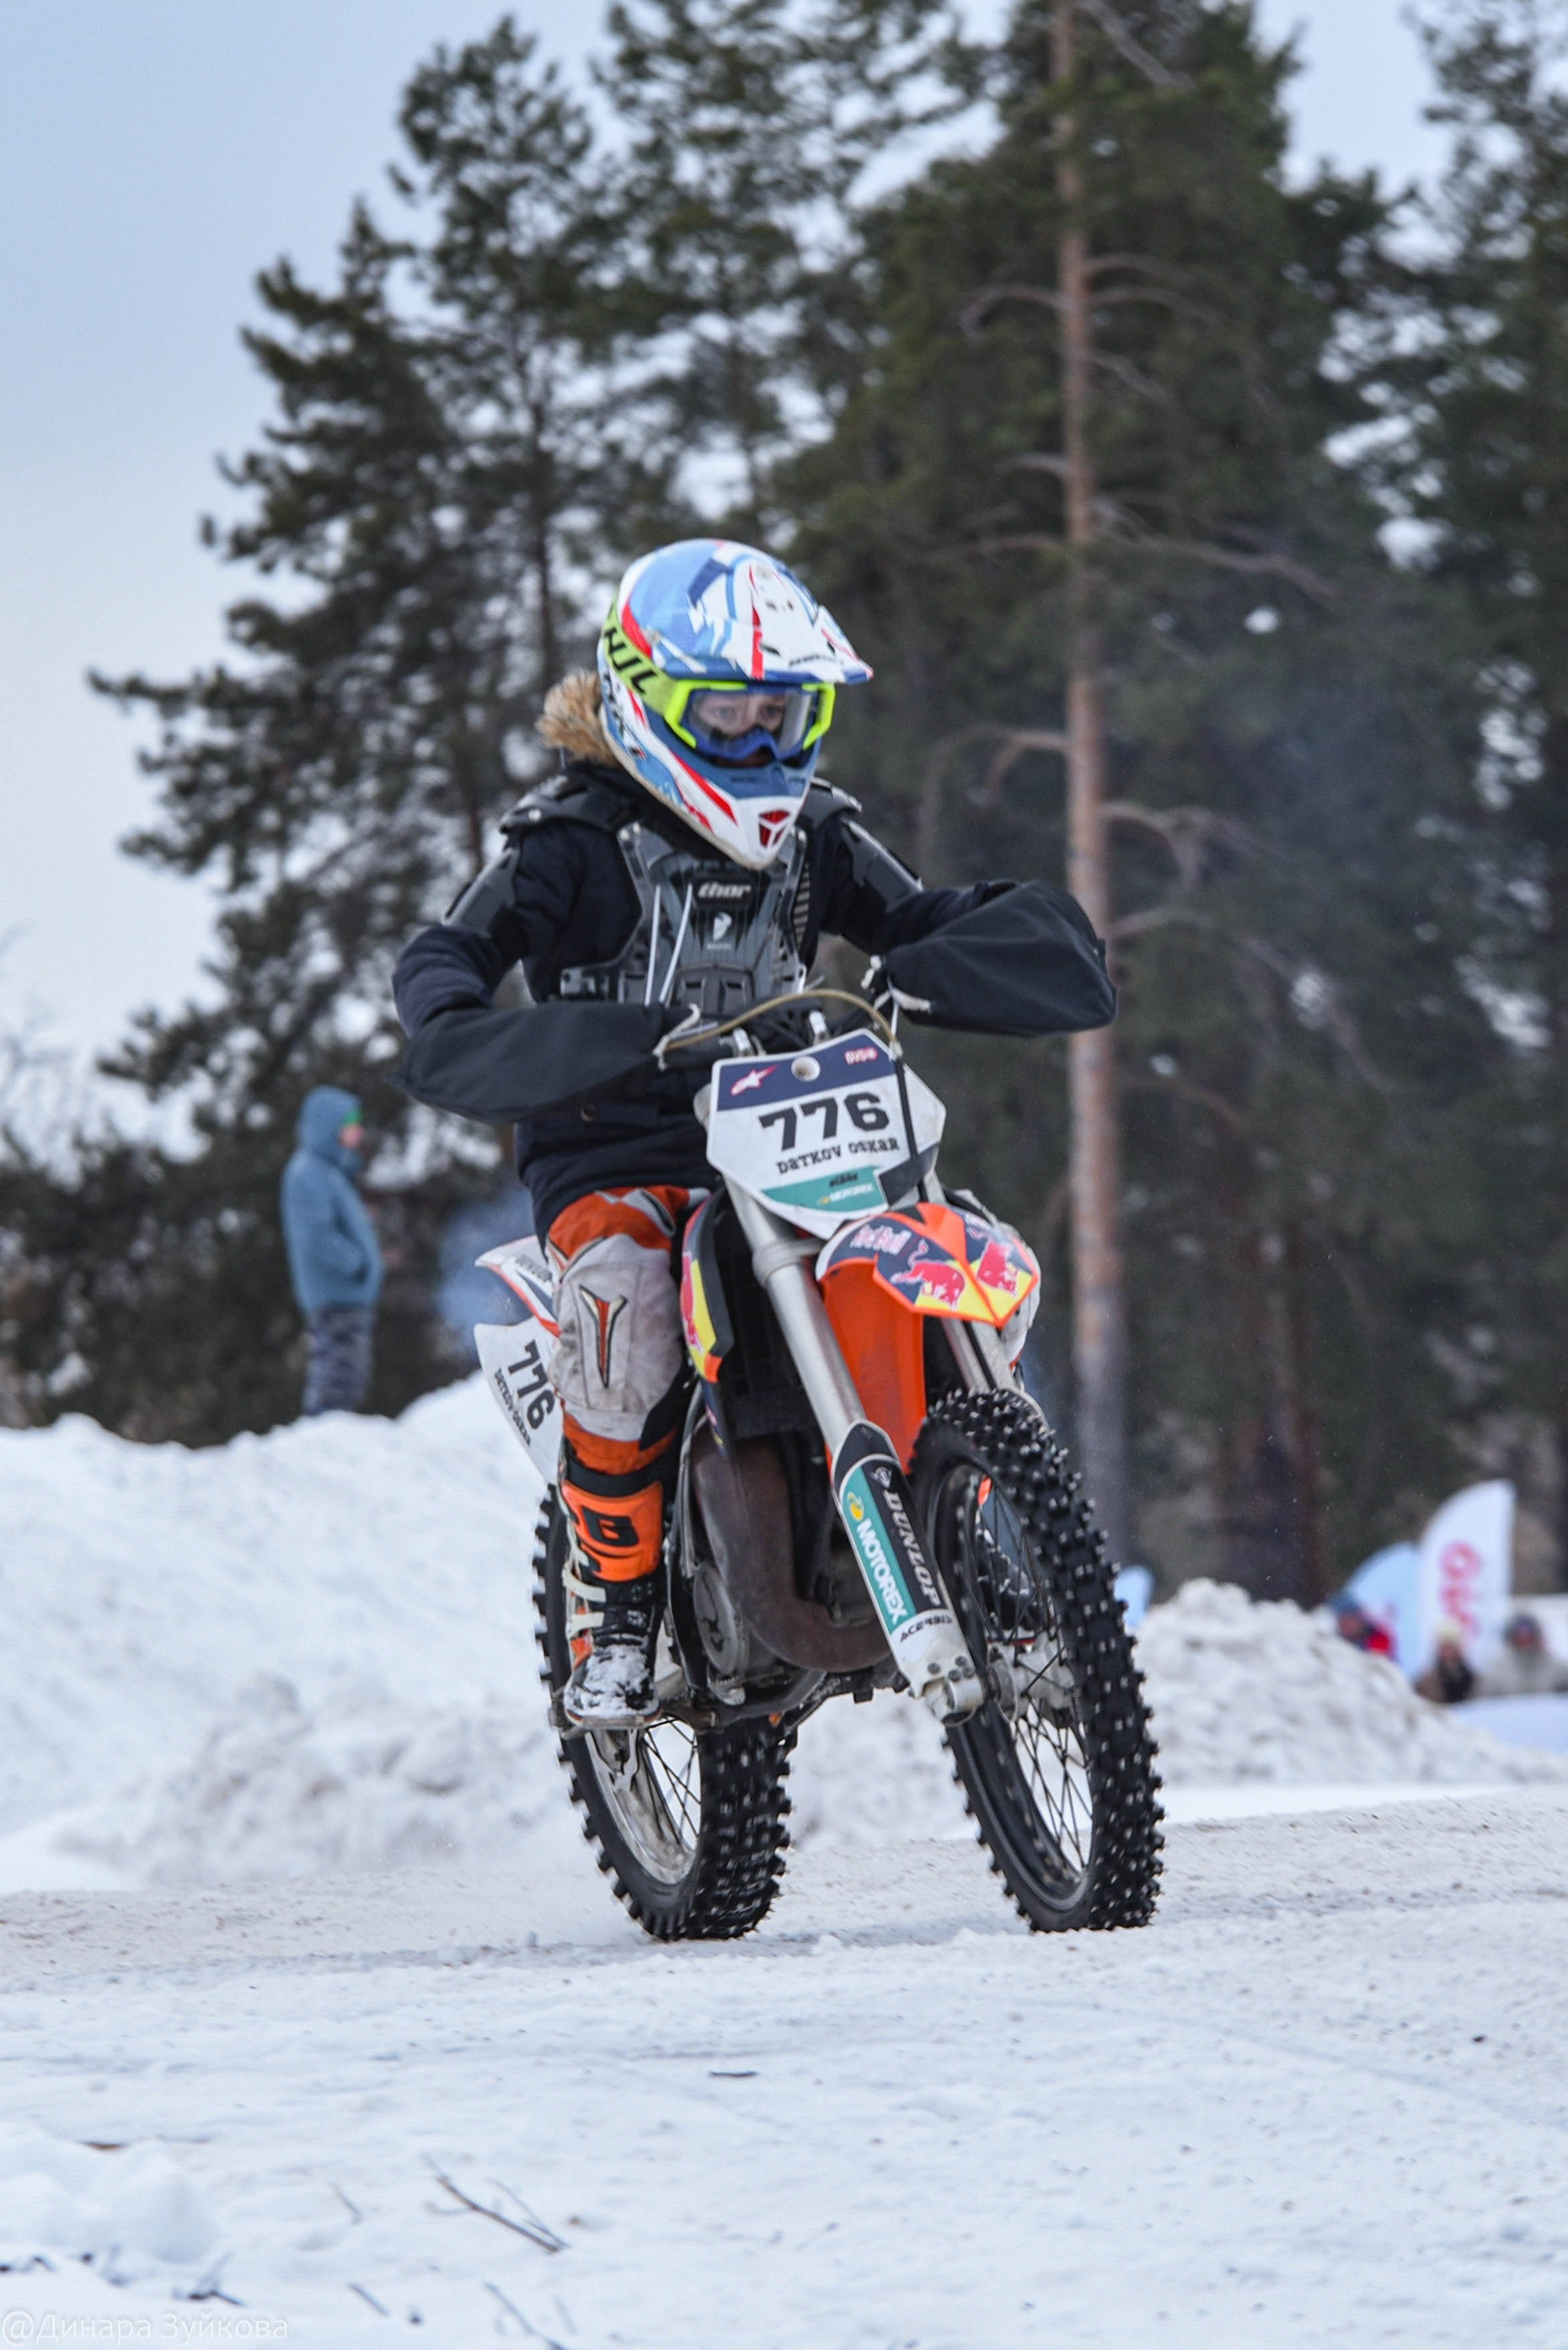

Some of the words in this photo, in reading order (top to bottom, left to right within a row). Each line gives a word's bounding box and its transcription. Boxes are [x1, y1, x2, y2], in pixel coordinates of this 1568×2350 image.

[758, 1092, 890, 1151] 776
[508, 1339, 557, 1430] 776
[856, 1518, 908, 1626] MOTOREX
[883, 1489, 943, 1607] DUNLOP
[899, 1613, 953, 1642] ACERBIS
